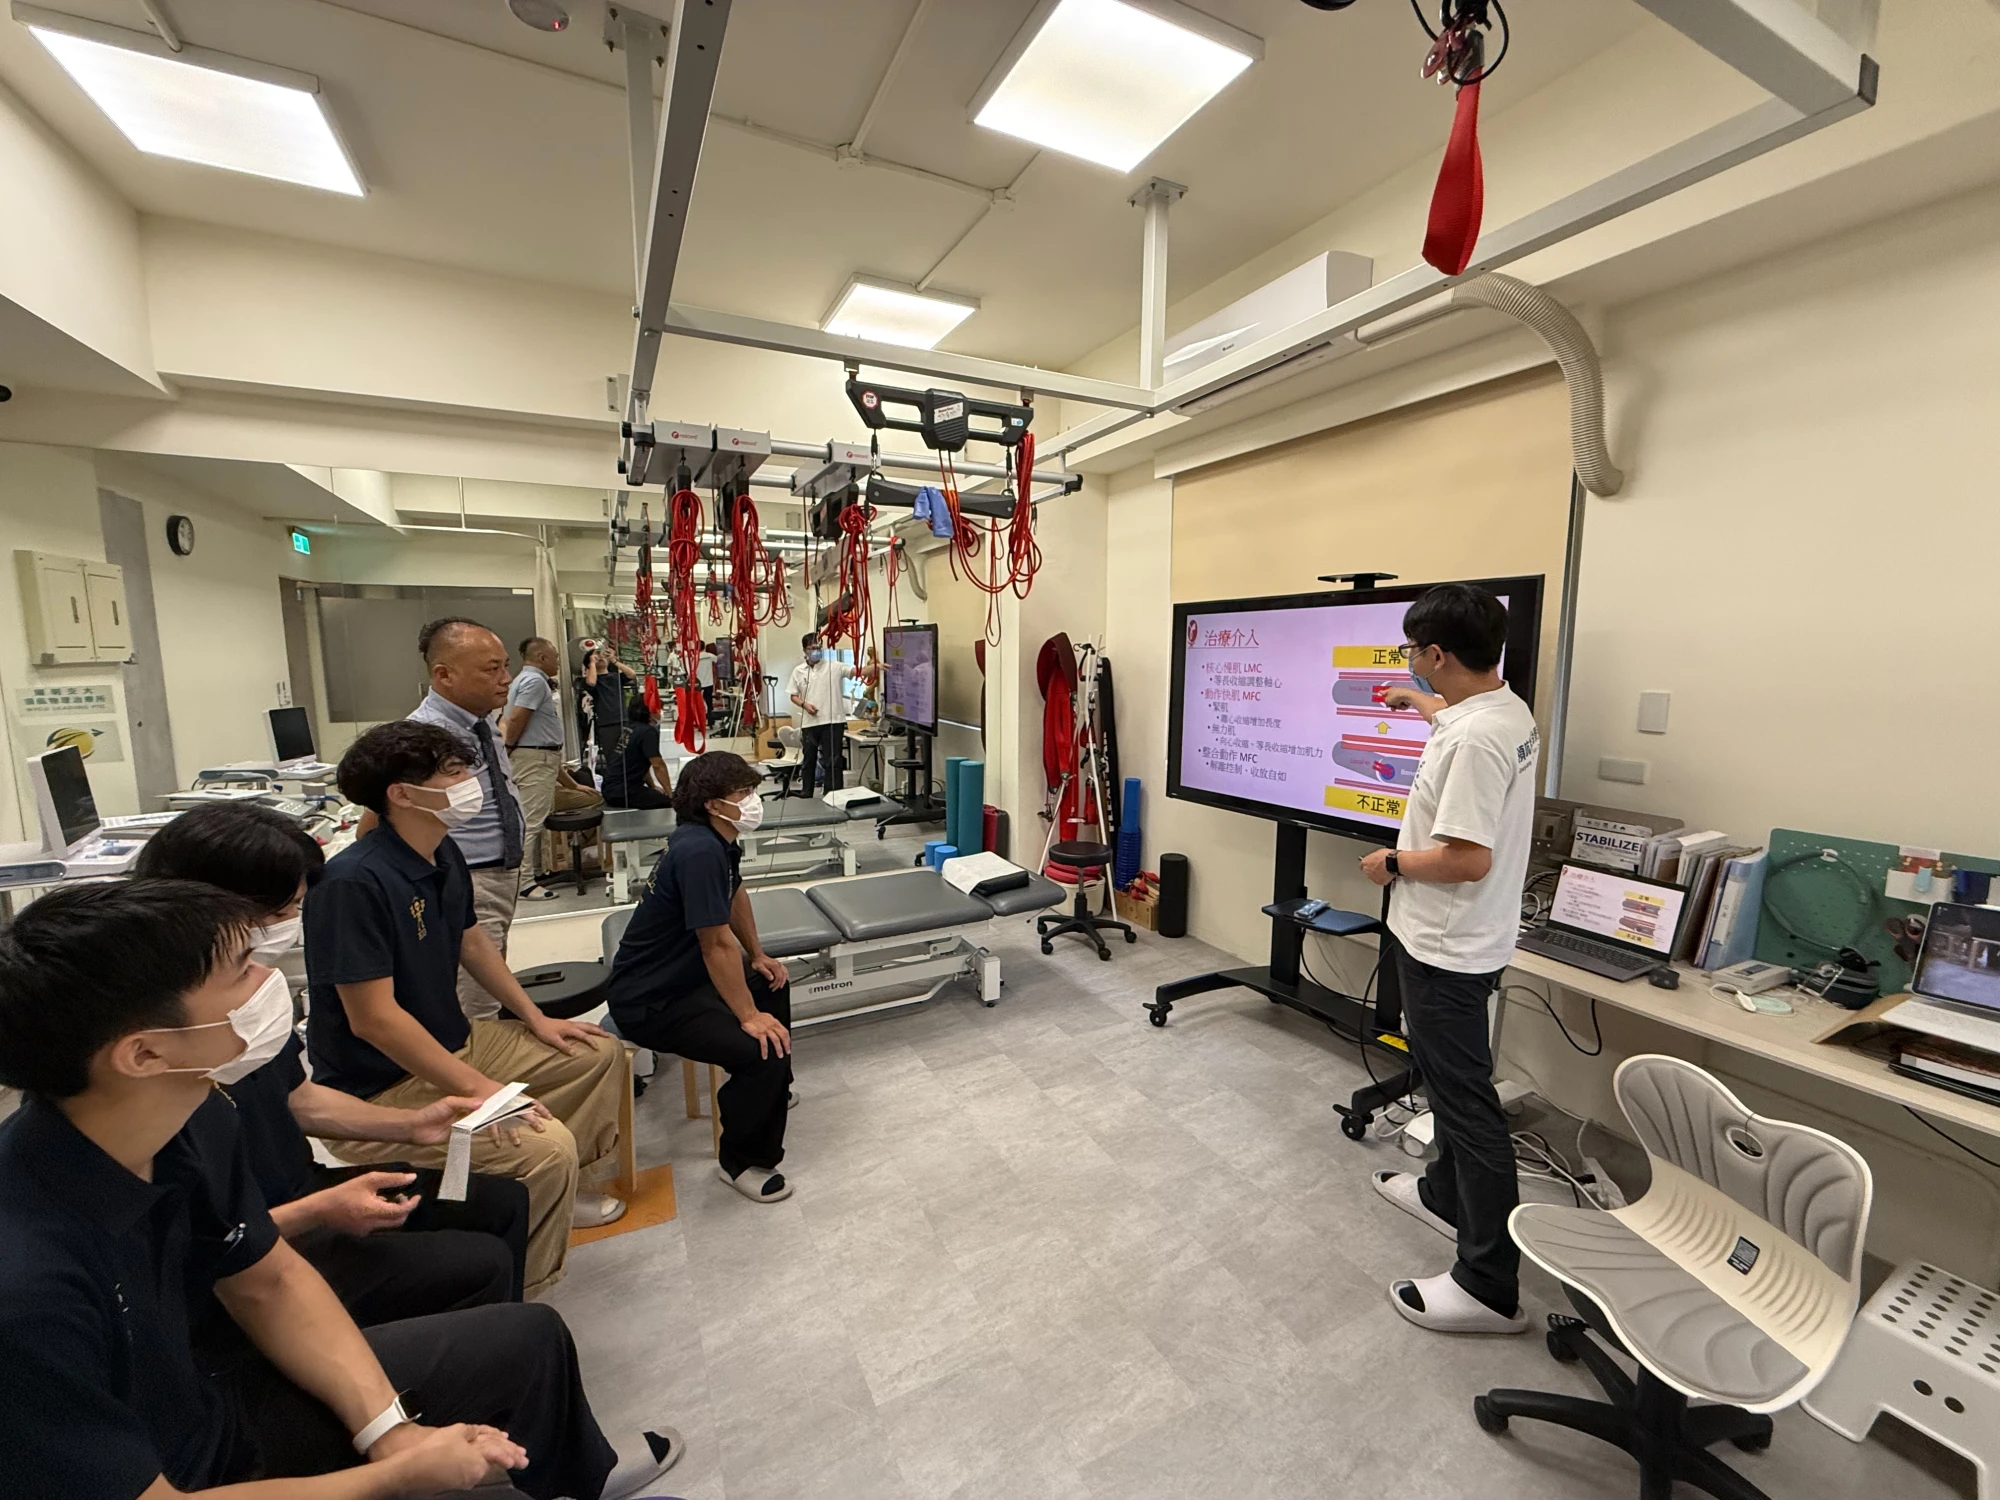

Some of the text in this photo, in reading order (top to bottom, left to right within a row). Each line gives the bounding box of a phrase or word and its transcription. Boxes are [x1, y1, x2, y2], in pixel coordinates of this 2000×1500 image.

[1203, 628, 1259, 648] 治療介入
[1372, 649, 1401, 665] 正常
[1243, 663, 1263, 674] LMC
[1242, 690, 1261, 702] MFC
[1201, 746, 1258, 764] 整合動作 MFC
[1356, 793, 1401, 816] 不正常
[813, 980, 853, 993] metron
